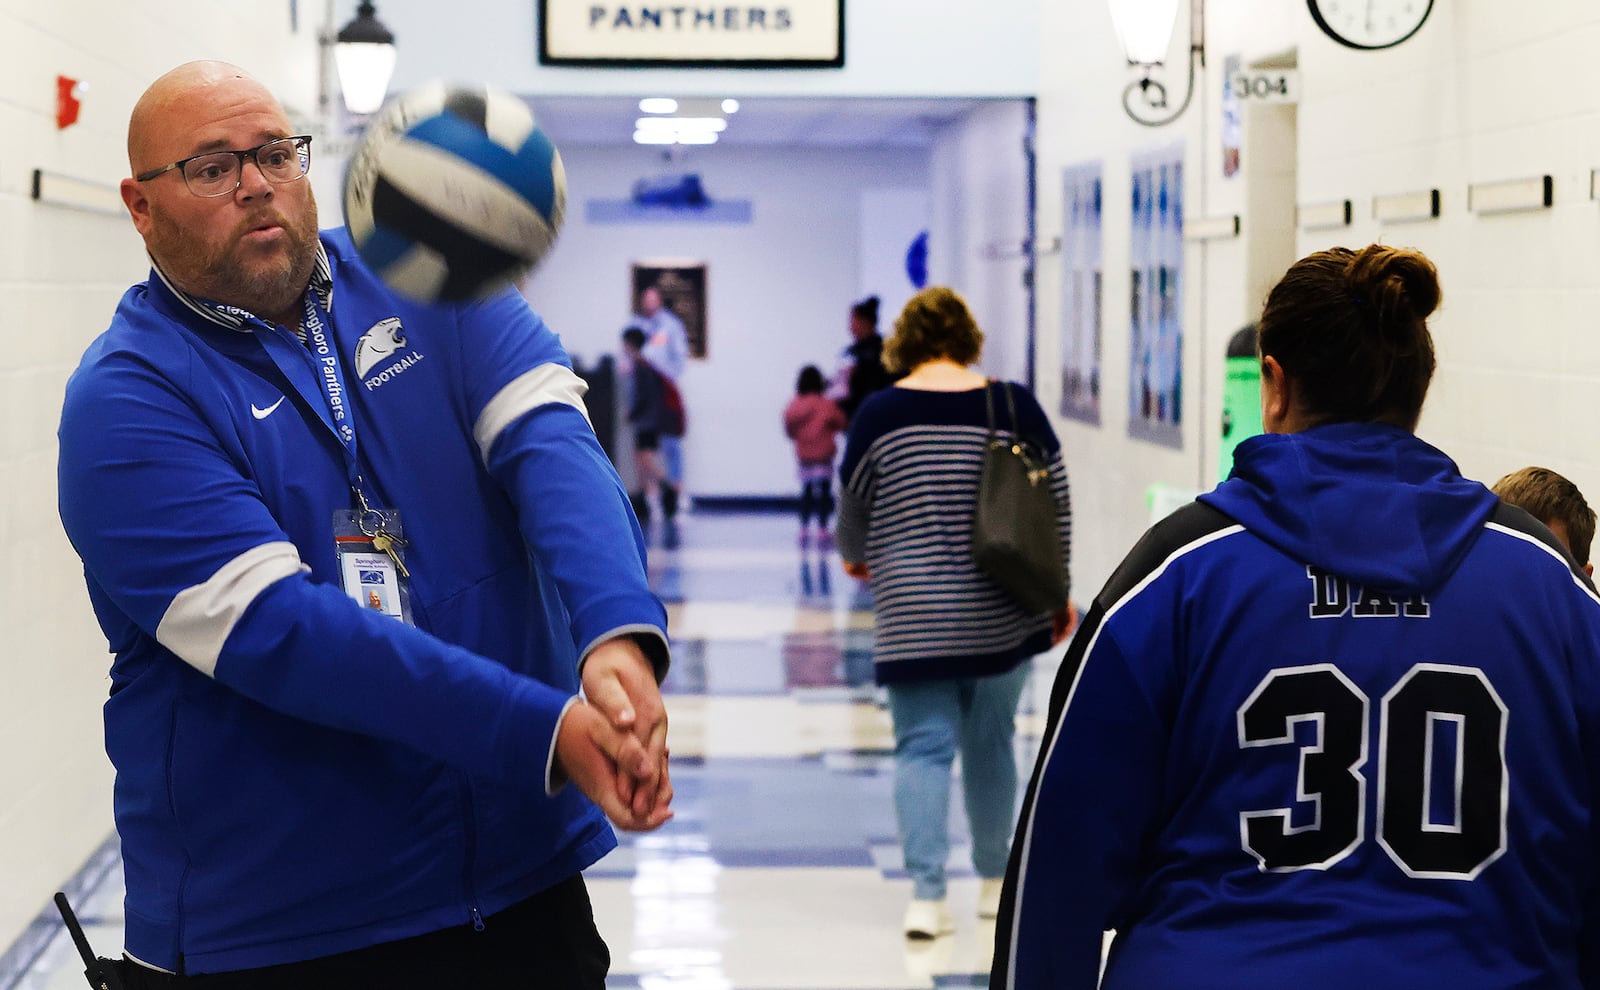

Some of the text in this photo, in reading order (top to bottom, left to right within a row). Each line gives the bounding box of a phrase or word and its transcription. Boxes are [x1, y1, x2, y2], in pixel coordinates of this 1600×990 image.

[588, 6, 793, 30] PANTHERS
[1234, 76, 1288, 99] 304
[321, 356, 345, 421] Panthers
[364, 351, 425, 391] FOOTBALL
[1236, 662, 1510, 881] 30
